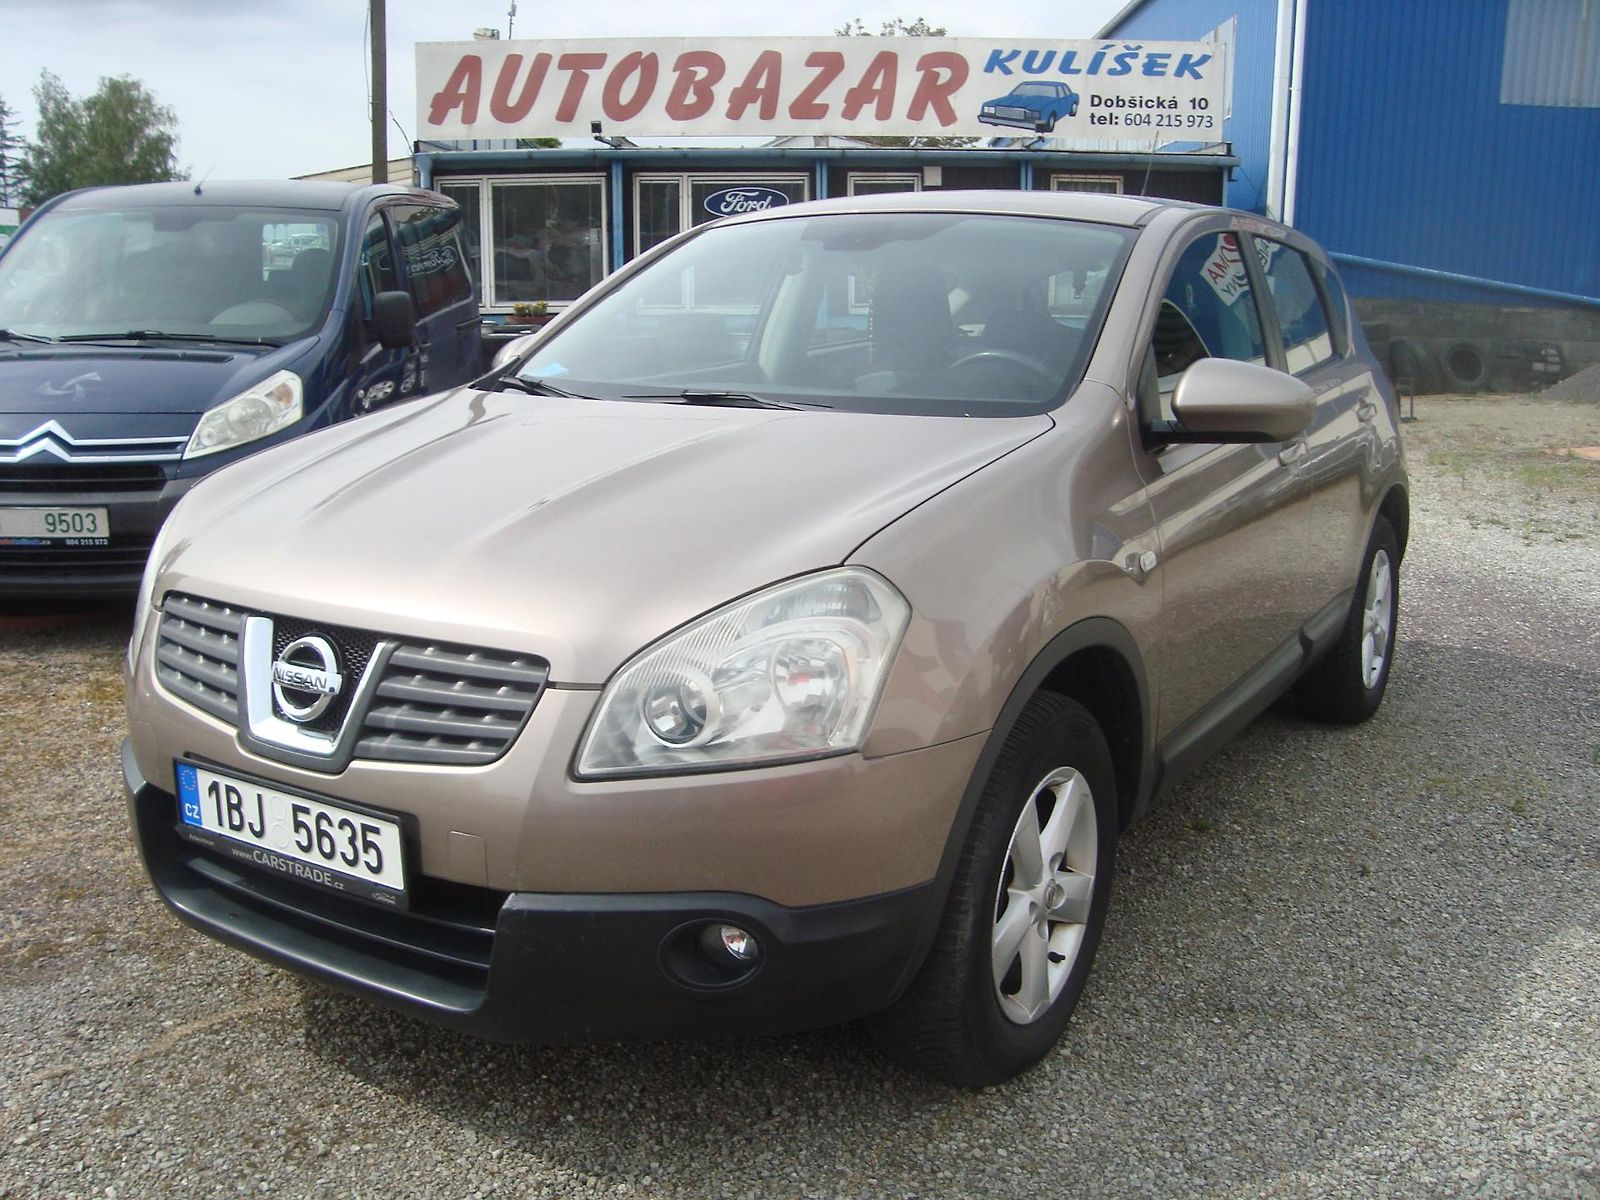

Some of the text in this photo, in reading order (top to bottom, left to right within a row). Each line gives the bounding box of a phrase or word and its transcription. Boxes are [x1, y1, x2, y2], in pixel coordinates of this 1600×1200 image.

[983, 44, 1213, 80] KULÍŠEK
[428, 50, 969, 127] AUTOBAZAR
[1090, 94, 1209, 110] Dobšická 10
[1090, 112, 1213, 129] tel: 604 215 973
[720, 191, 772, 212] Ford
[45, 512, 97, 533] 9503
[273, 667, 328, 689] NISSAN
[184, 802, 200, 819] CZ
[208, 780, 383, 875] 1BJ 5635
